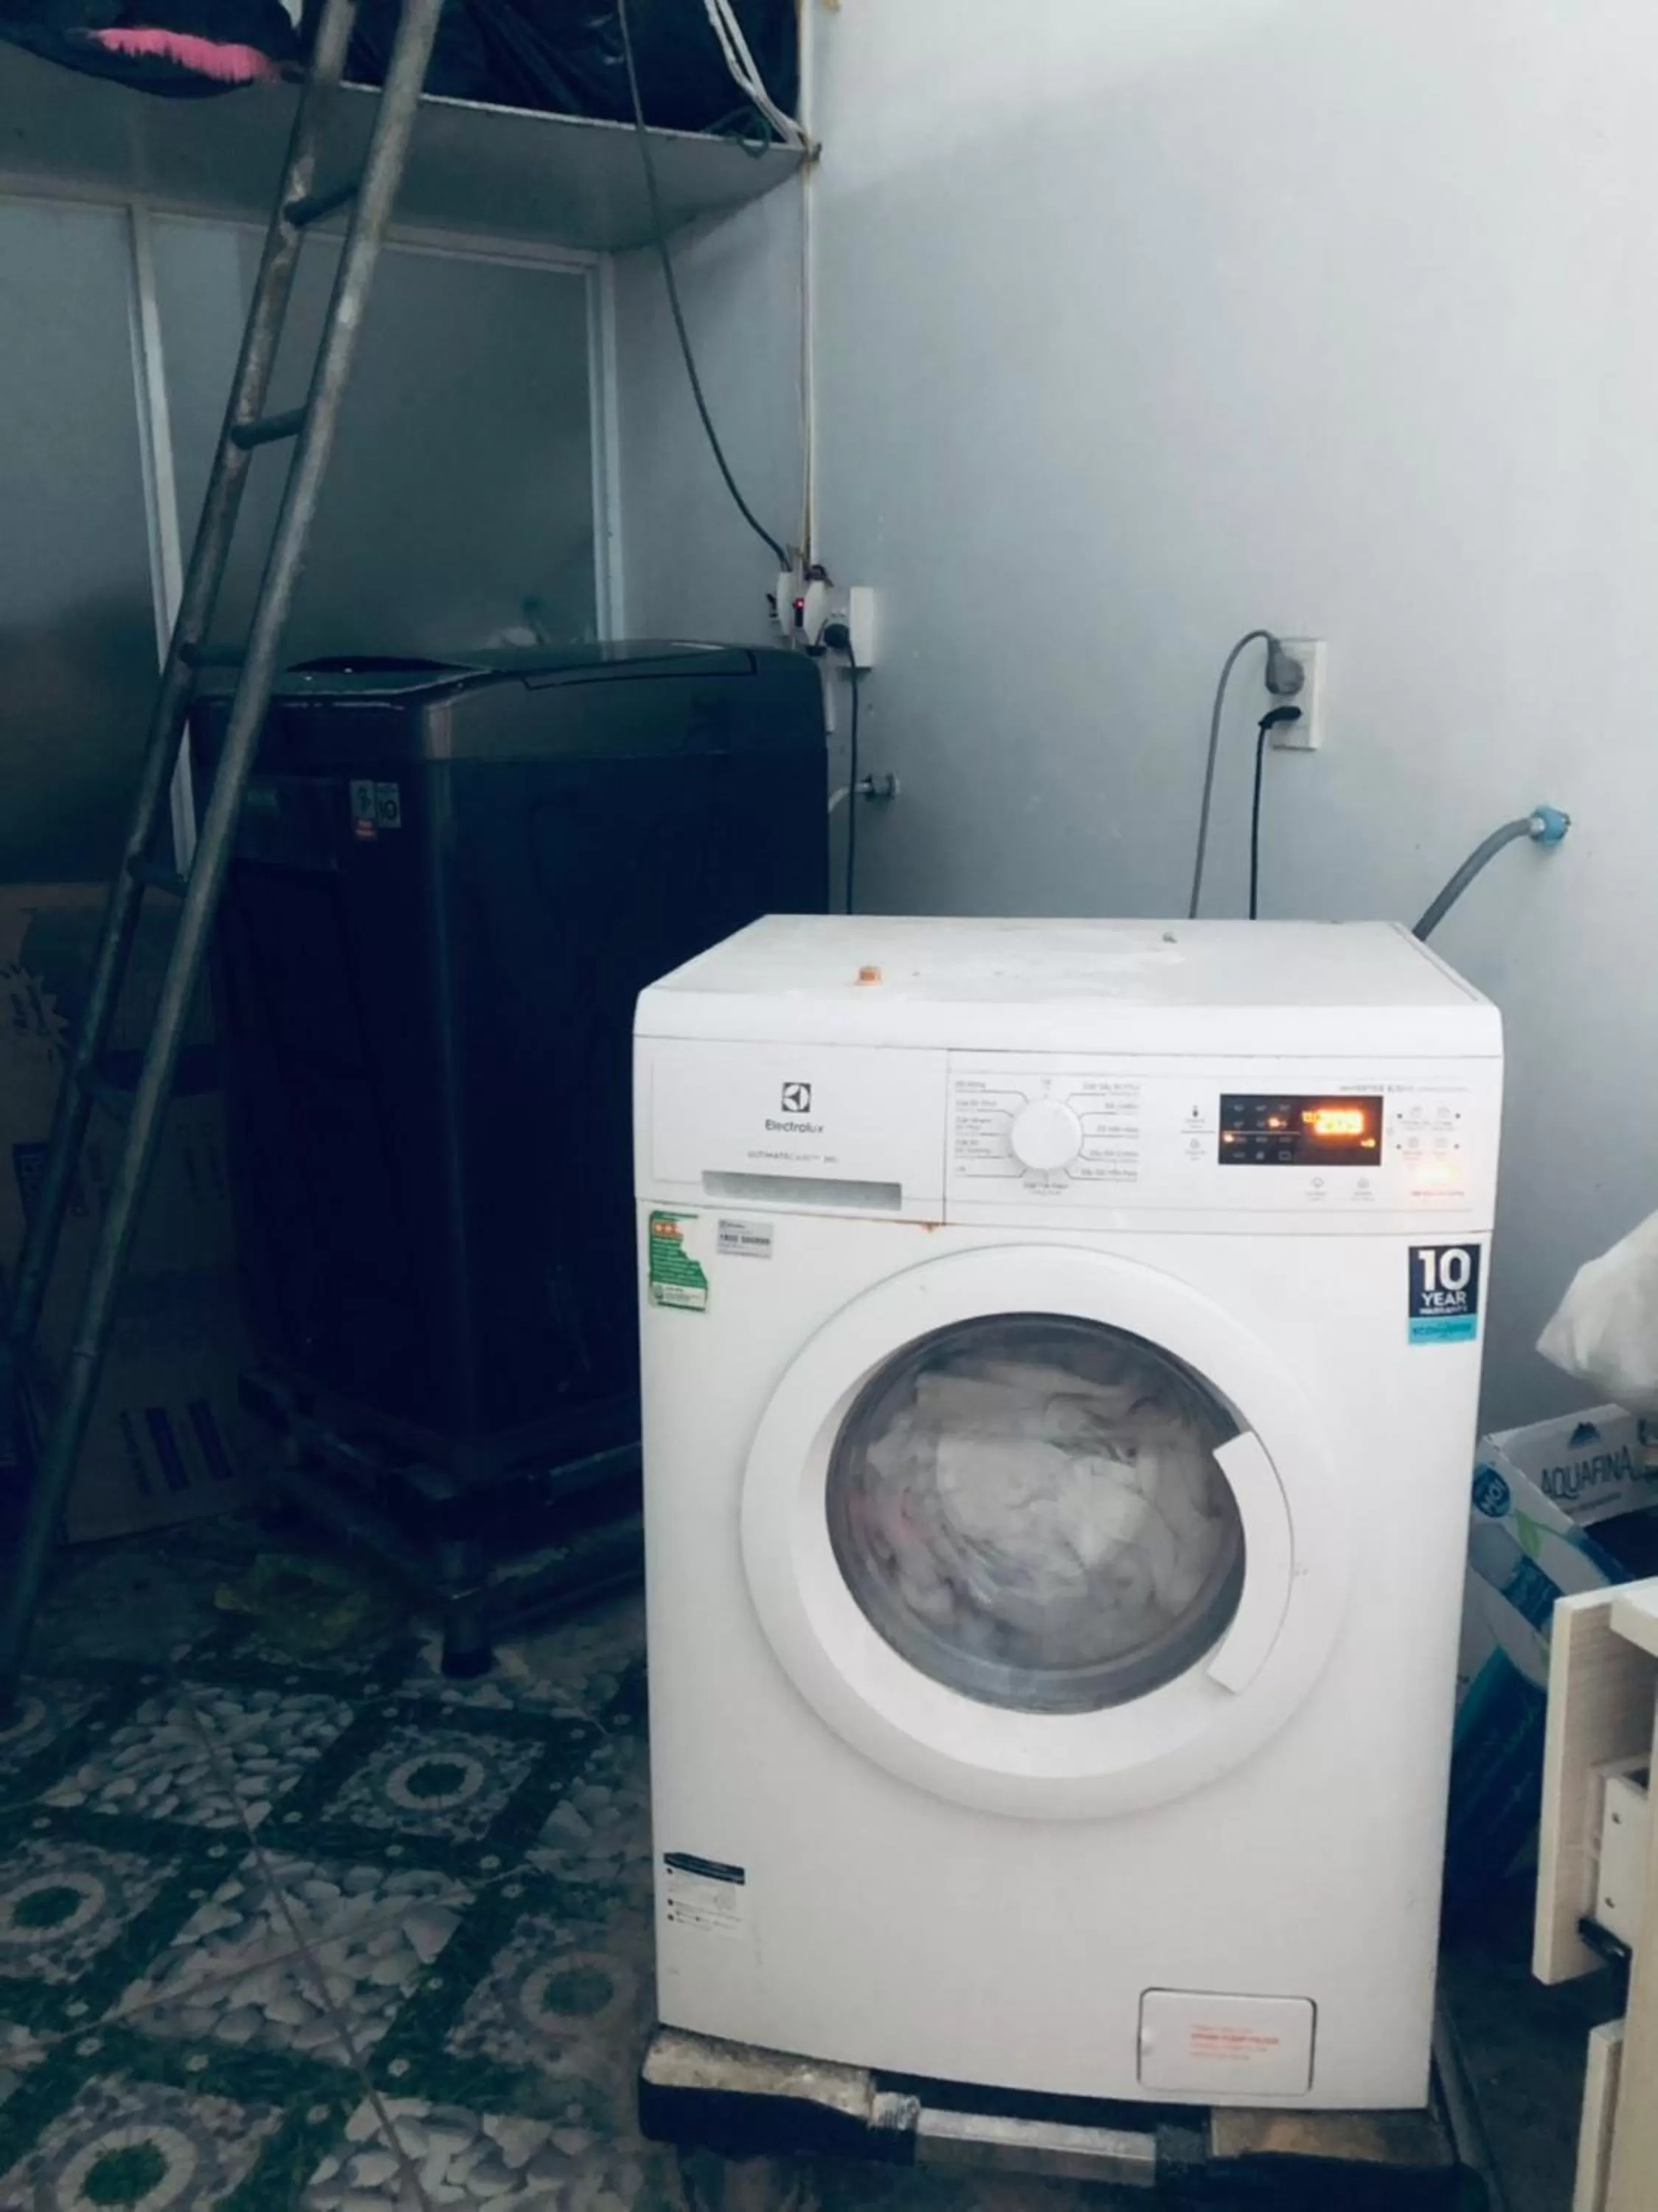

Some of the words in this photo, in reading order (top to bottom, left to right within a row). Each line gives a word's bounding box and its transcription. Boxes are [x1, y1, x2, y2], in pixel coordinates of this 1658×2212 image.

[765, 1119, 824, 1133] Electrolux
[1418, 1248, 1471, 1291] 10
[1421, 1291, 1467, 1307] YEAR
[1541, 1444, 1638, 1500] AQUAFINA
